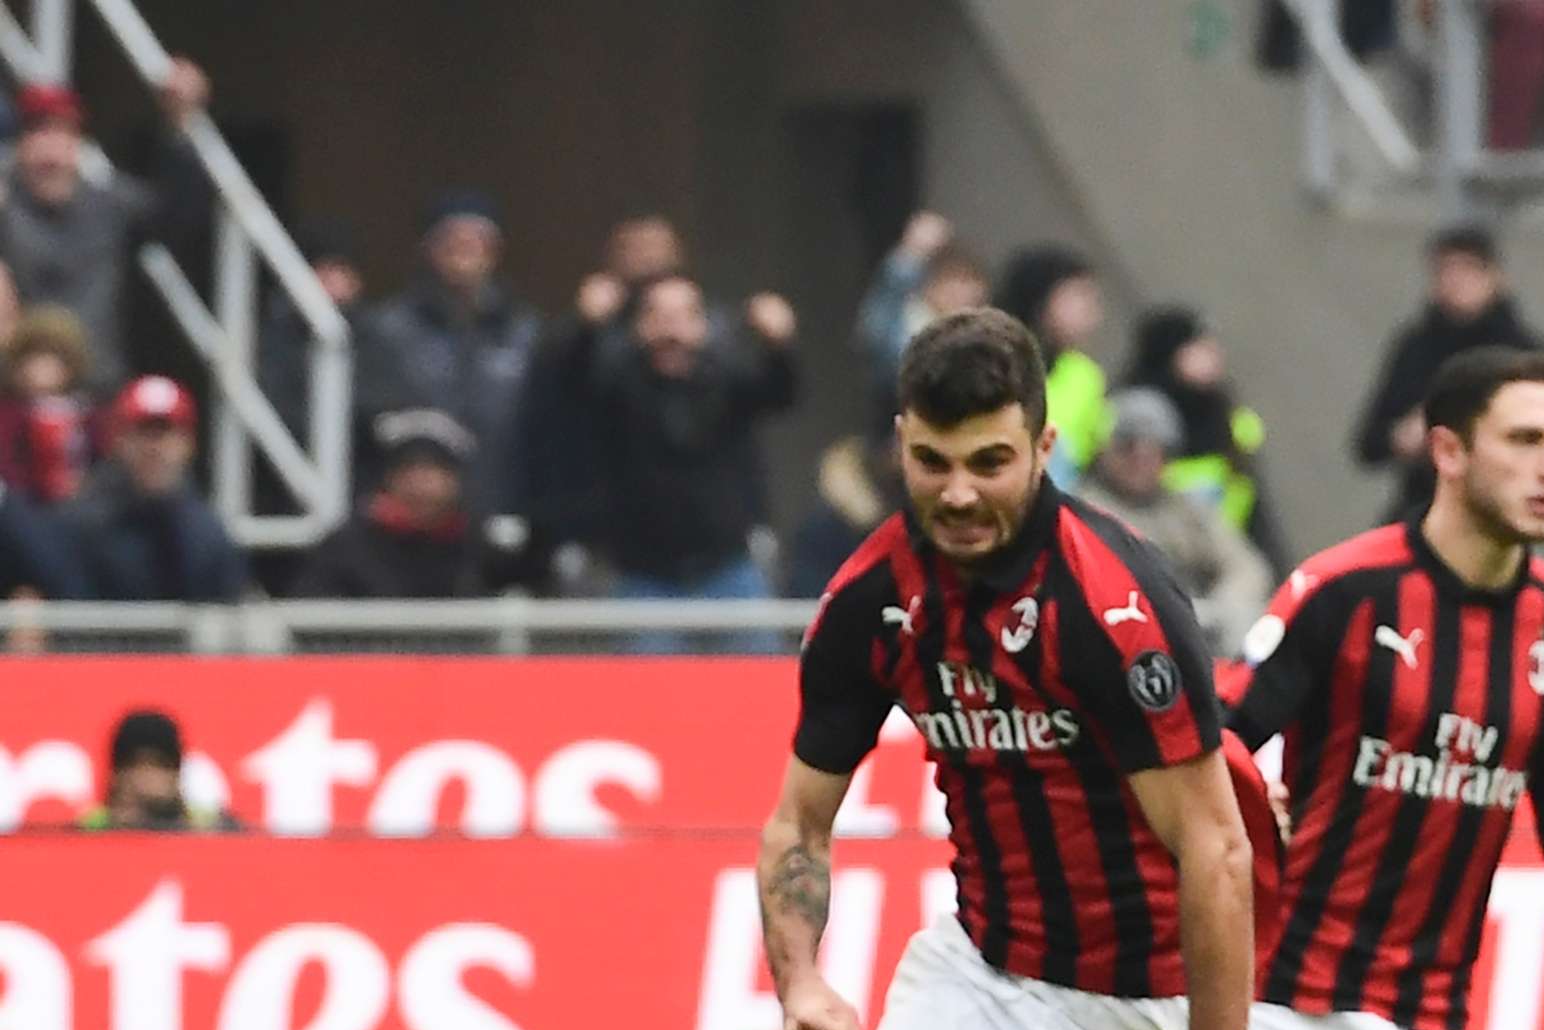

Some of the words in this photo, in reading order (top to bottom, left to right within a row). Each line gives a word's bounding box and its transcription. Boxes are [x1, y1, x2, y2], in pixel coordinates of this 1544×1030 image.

[937, 661, 997, 702] Fly
[913, 698, 1079, 752] mirates
[1435, 712, 1499, 762] Fly
[1353, 735, 1528, 811] Emirate
